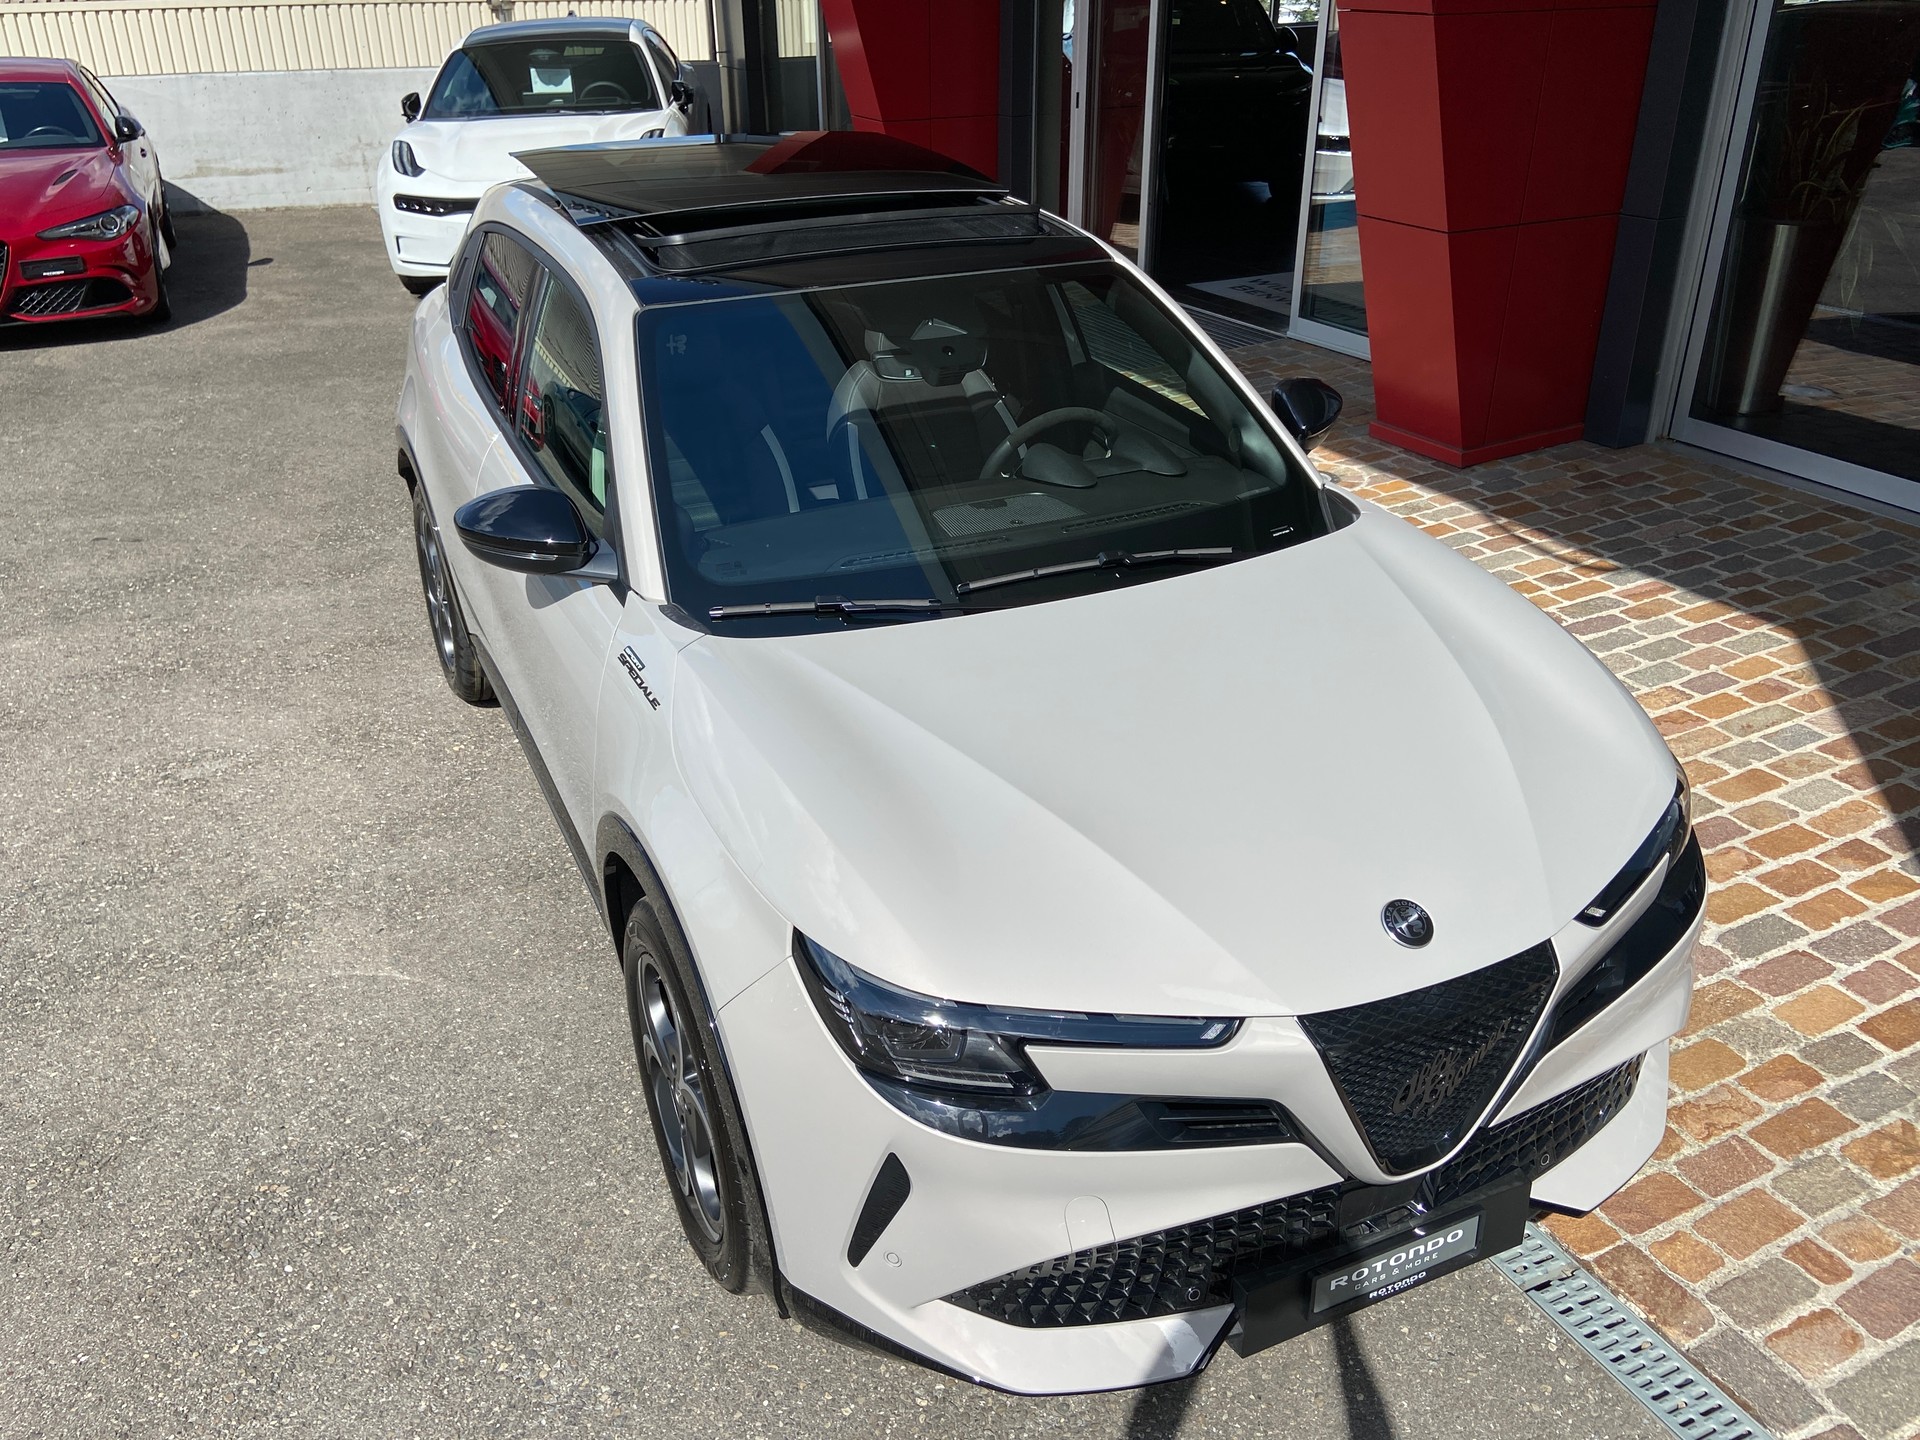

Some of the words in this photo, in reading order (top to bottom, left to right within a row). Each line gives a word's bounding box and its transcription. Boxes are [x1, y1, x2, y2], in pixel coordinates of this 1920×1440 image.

[617, 653, 661, 711] SPECIALE
[1386, 906, 1395, 928] ALFA
[1394, 901, 1428, 918] ROMEO
[1330, 1229, 1464, 1291] ROTONDO
[1354, 1272, 1387, 1291] CARS
[1392, 1267, 1400, 1276] &
[1405, 1252, 1440, 1271] MORE
[1369, 1271, 1426, 1298] ROTONDO
